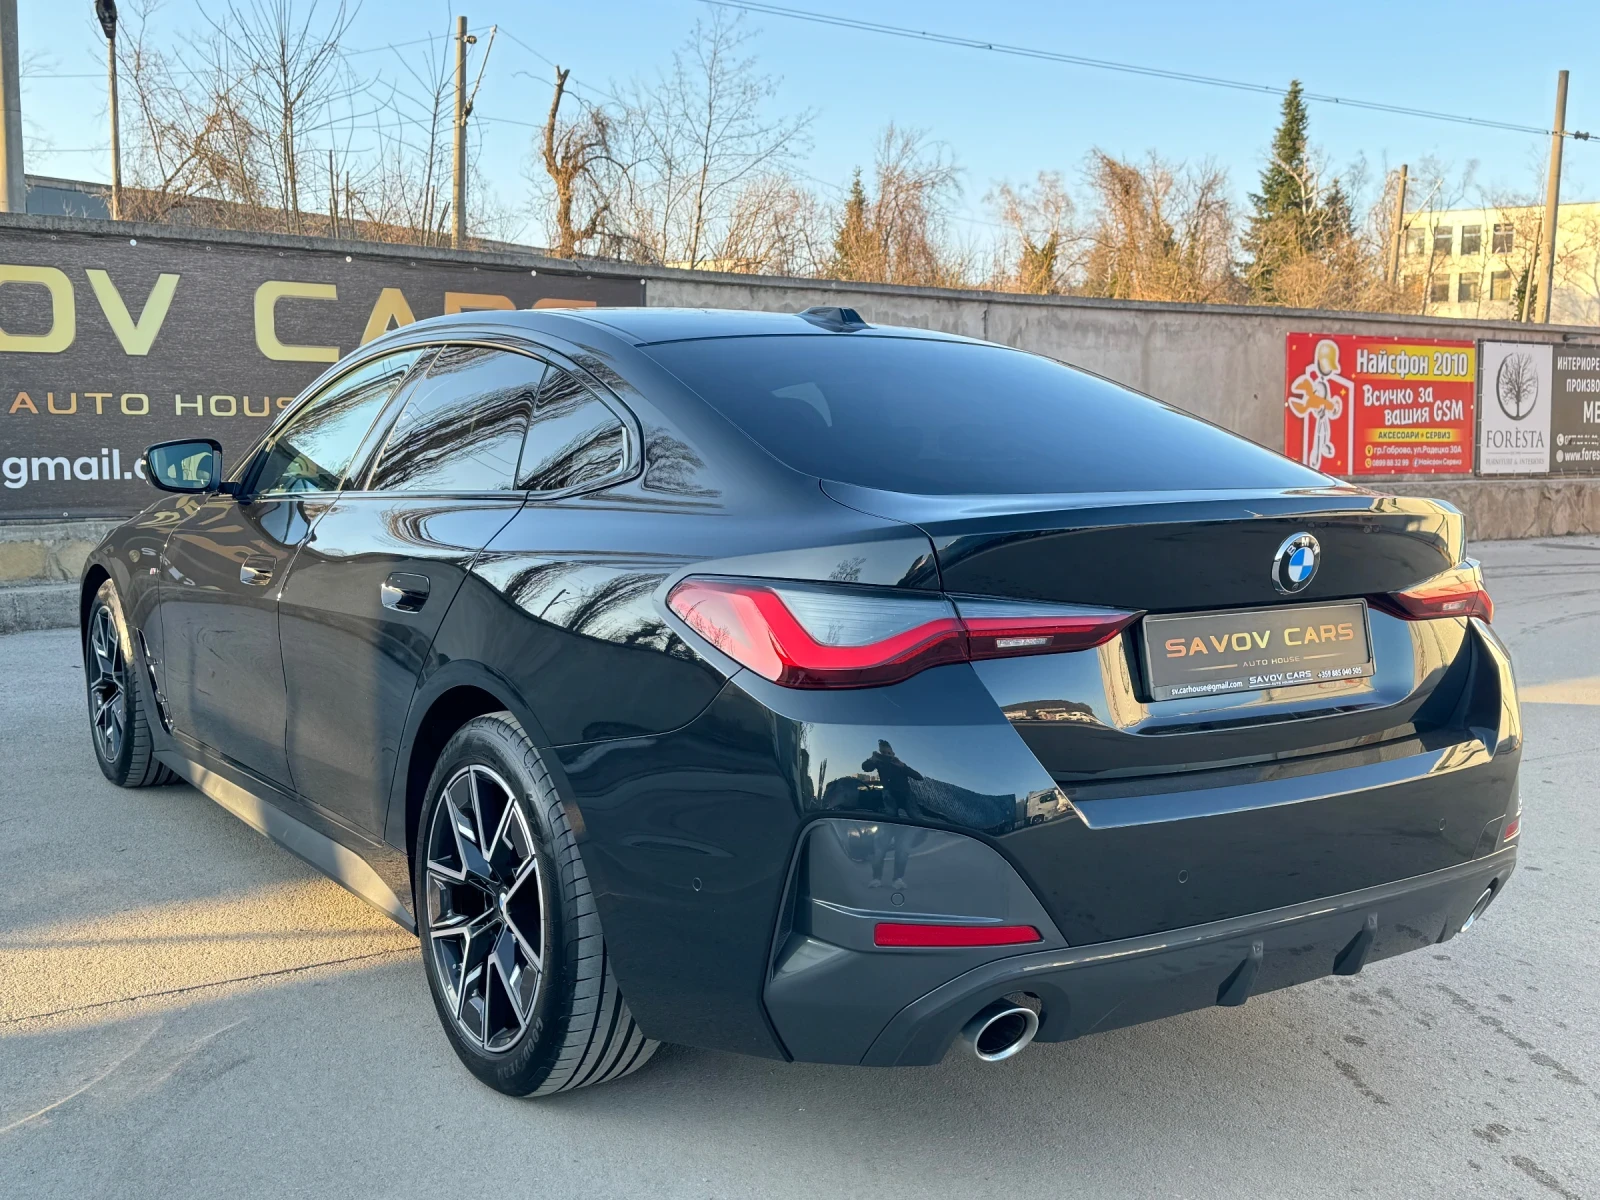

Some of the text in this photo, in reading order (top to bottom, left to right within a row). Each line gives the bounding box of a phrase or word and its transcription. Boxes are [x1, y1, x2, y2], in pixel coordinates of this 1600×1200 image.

[254, 280, 598, 363] CA
[1356, 348, 1468, 379] Найсфон 2010
[9, 391, 150, 415] AUTO
[1362, 384, 1434, 407] Всичко за
[1384, 399, 1464, 426] вашия GSM
[1378, 431, 1451, 440] АКСЕСОАРИ СЕРВИЗ
[1486, 427, 1545, 449] FORÈSTA
[1287, 536, 1320, 556] BMW
[1165, 622, 1354, 658] SAVOV CARS
[1243, 655, 1300, 668] AUTO HOUSE
[1171, 681, 1243, 696] sv.carhouse@gmail.com
[1249, 673, 1283, 684] SAVOV
[1286, 670, 1312, 680] CARS
